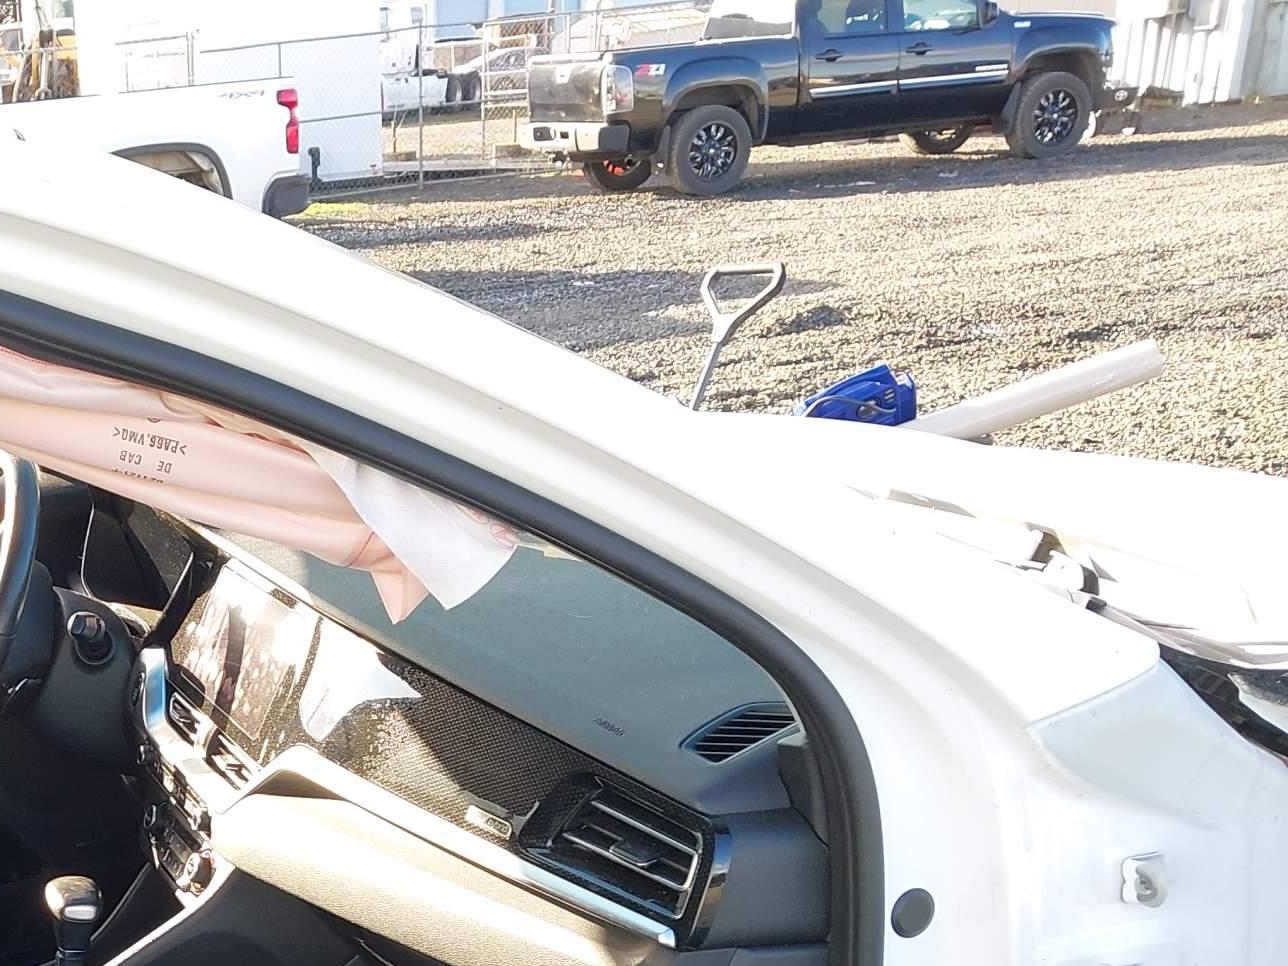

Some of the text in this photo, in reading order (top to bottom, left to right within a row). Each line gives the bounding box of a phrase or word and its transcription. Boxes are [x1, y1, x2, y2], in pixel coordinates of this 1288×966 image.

[634, 63, 666, 76] Z71
[119, 449, 172, 474] DE CAB
